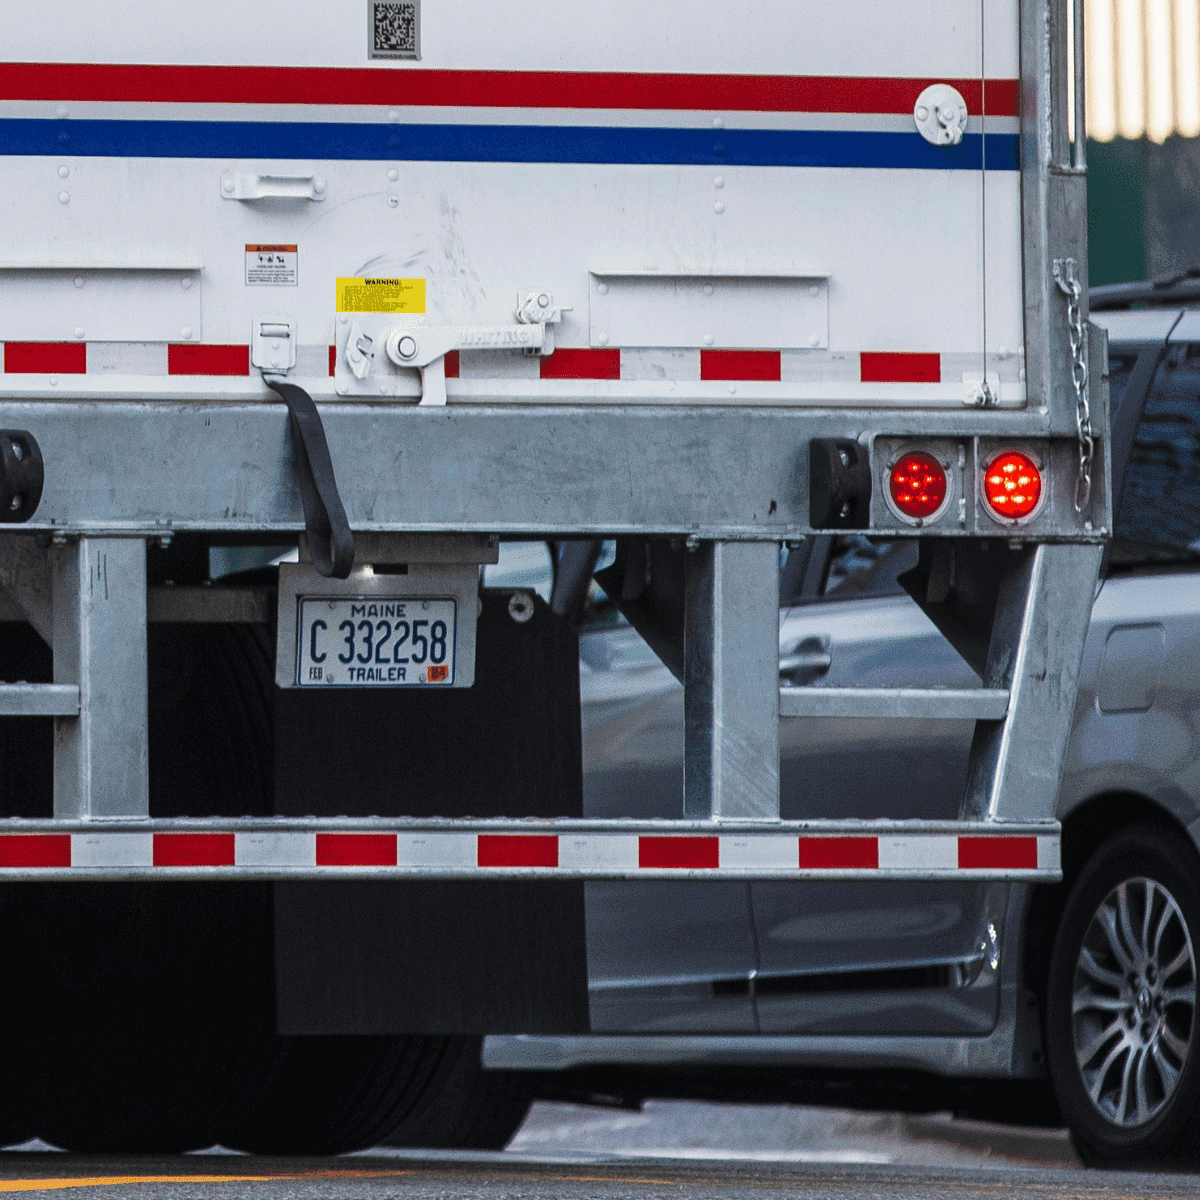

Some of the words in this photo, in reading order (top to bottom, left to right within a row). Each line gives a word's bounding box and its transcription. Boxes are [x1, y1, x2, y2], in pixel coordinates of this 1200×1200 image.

[364, 278, 400, 286] WARNING
[350, 603, 407, 619] MAINE
[309, 619, 328, 664] C
[337, 619, 448, 665] 332258
[309, 666, 323, 681] FEB
[347, 667, 407, 682] TRAILER
